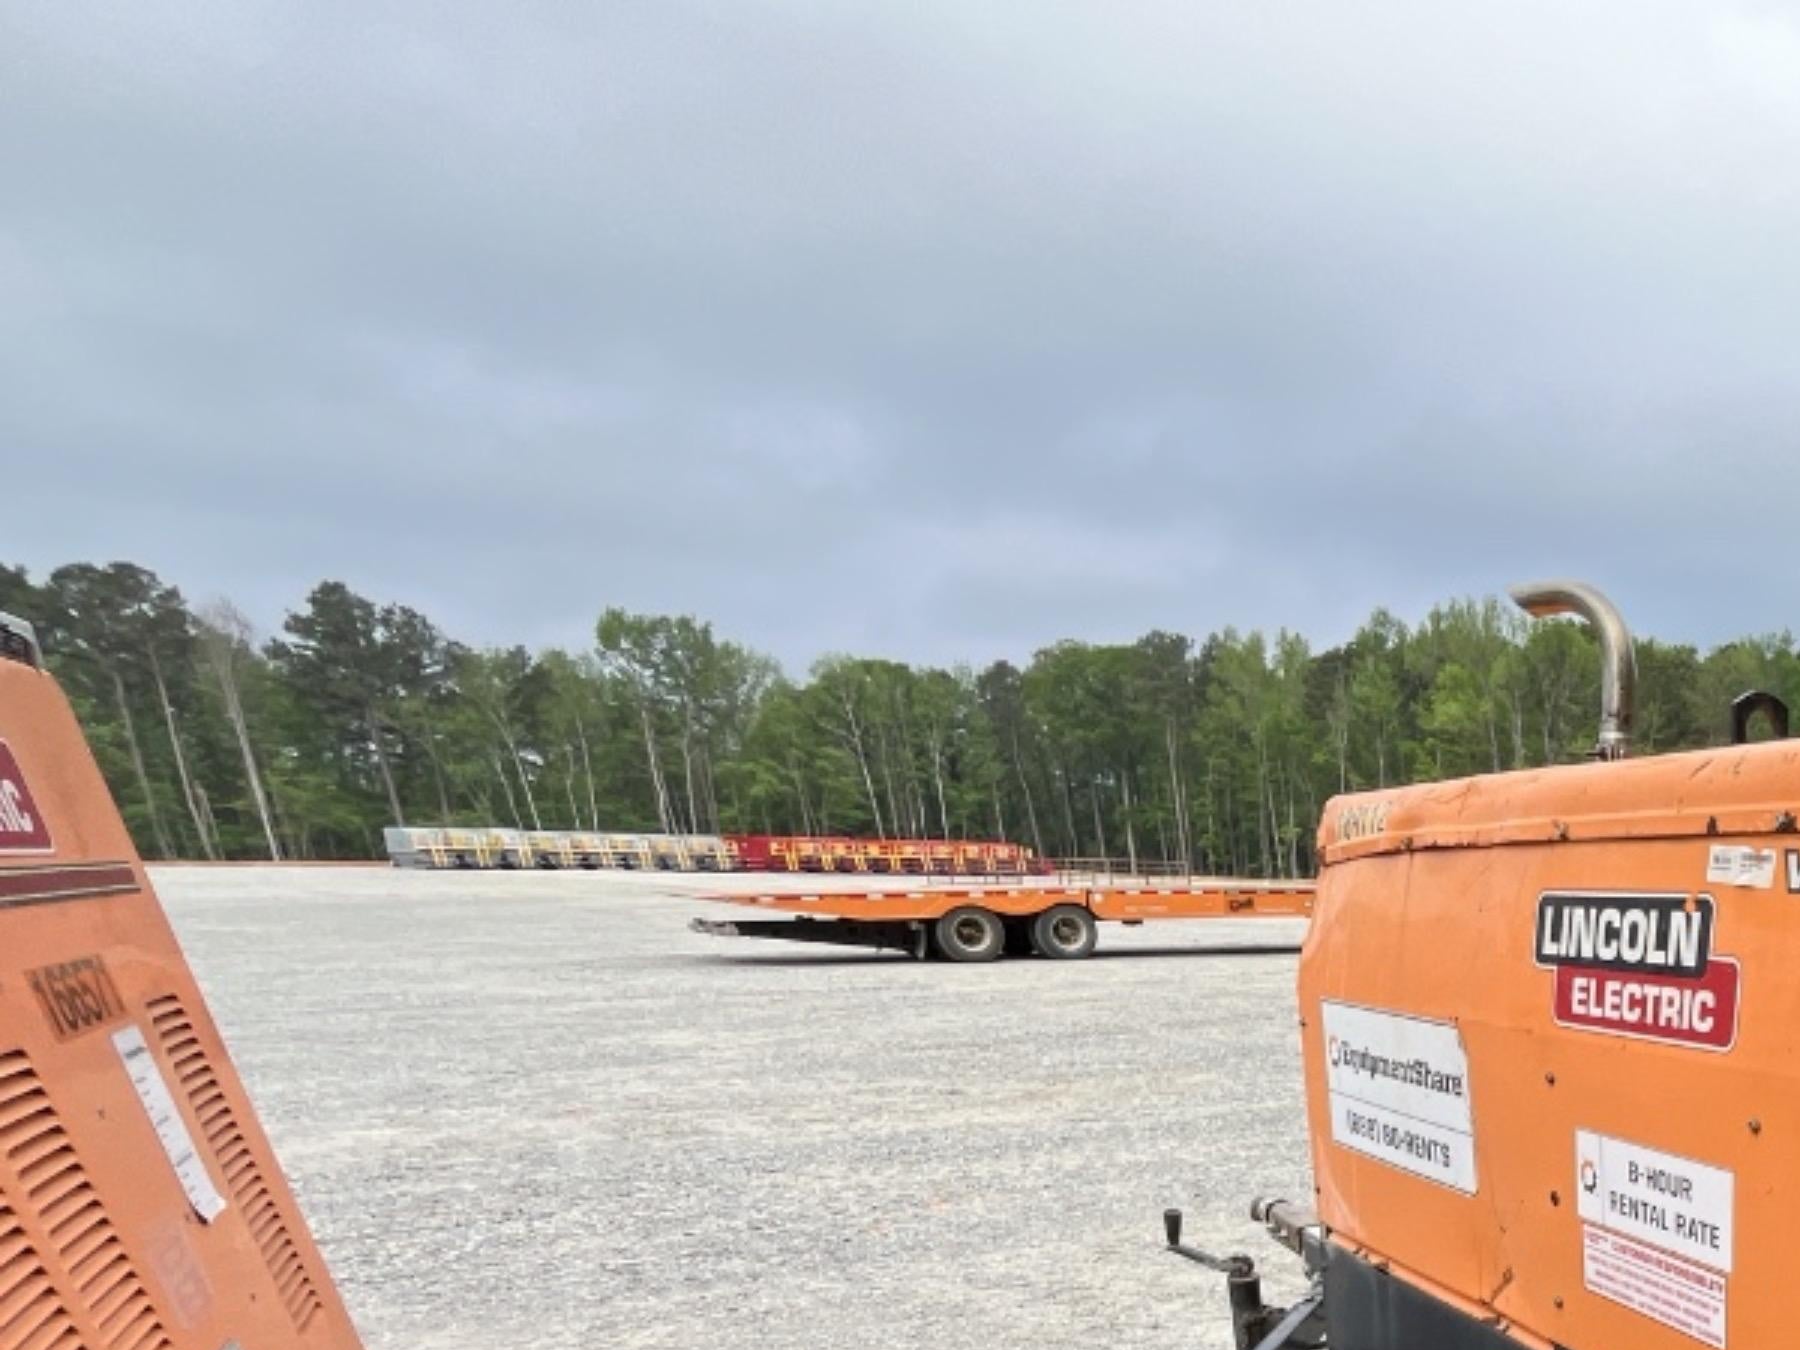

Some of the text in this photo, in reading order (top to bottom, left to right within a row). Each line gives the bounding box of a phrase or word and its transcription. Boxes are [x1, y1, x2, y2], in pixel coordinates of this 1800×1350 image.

[1541, 905, 1703, 968] LINCOLN
[1570, 976, 1717, 1034] ELECTRIC
[1609, 1189, 1721, 1251] RENTAL RATE
